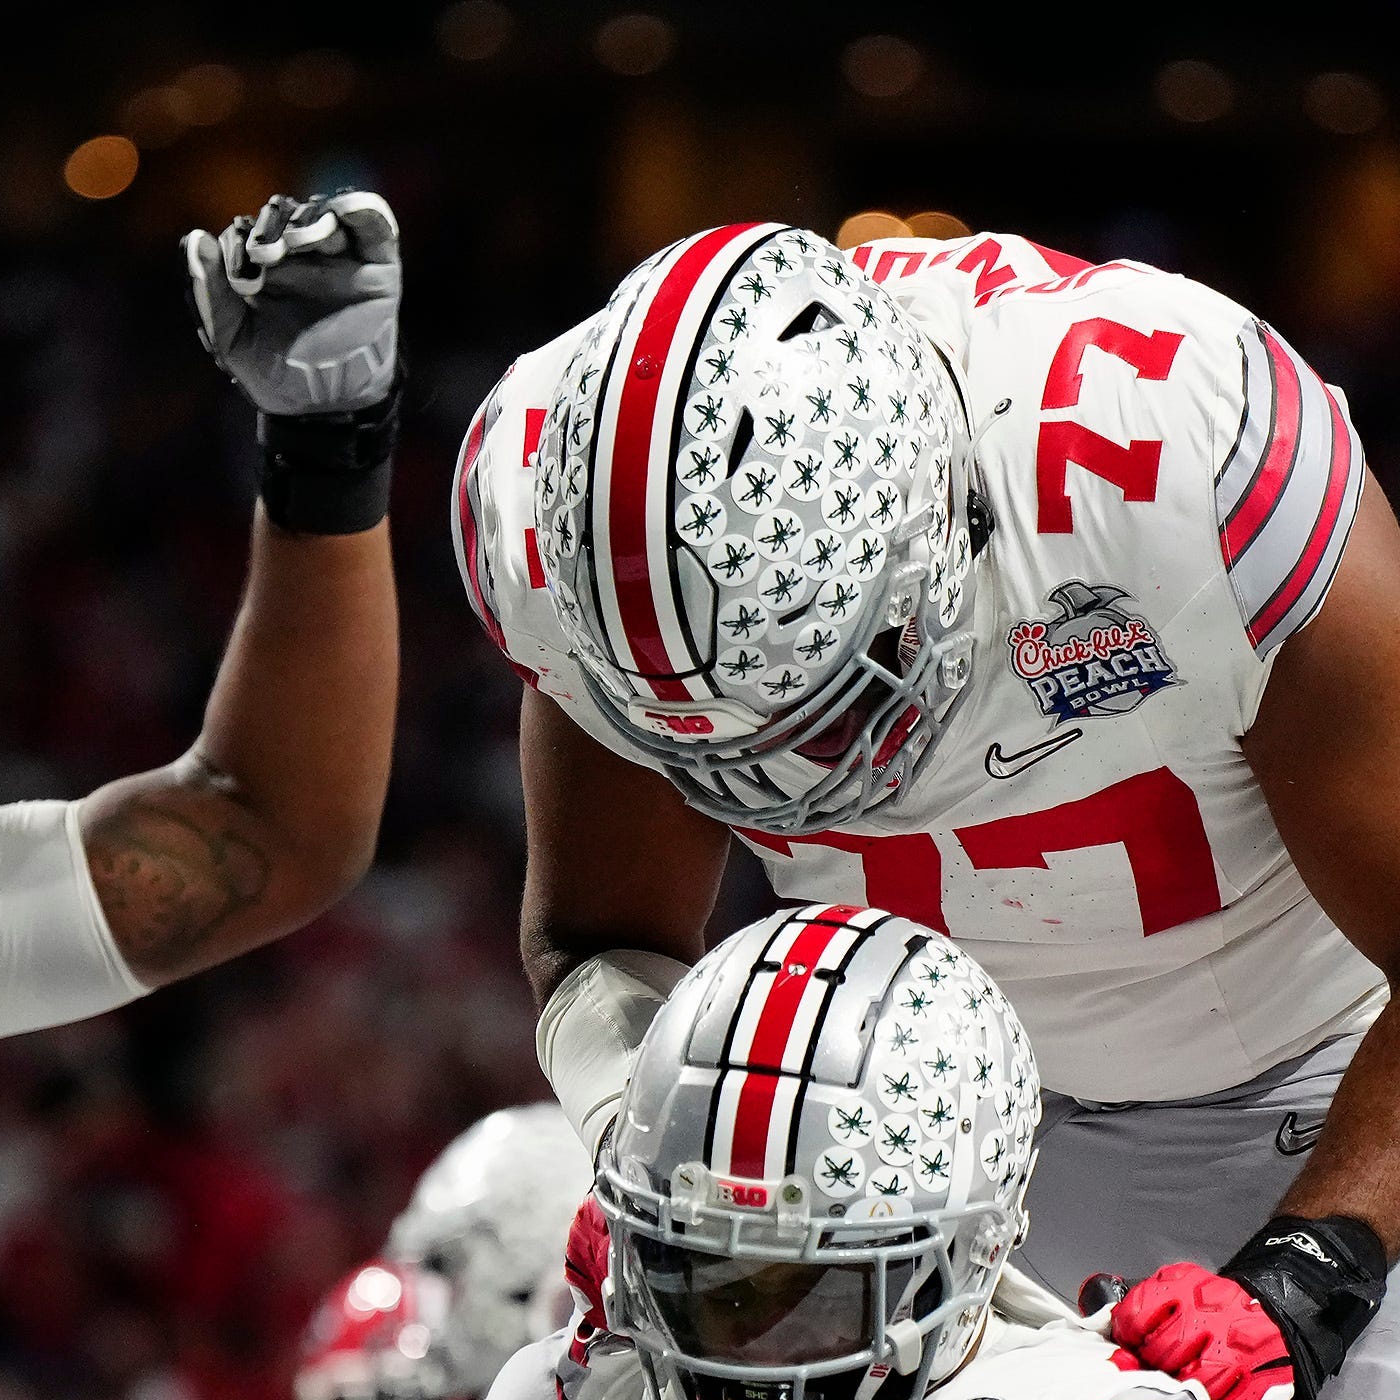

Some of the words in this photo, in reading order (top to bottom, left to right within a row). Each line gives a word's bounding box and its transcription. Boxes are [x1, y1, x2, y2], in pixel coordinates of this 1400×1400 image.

[1037, 317, 1185, 534] 77
[1012, 622, 1153, 676] Chick-fil-A
[1031, 646, 1171, 711] PEACH
[1069, 678, 1149, 709] BOWL
[728, 766, 1223, 938] 77
